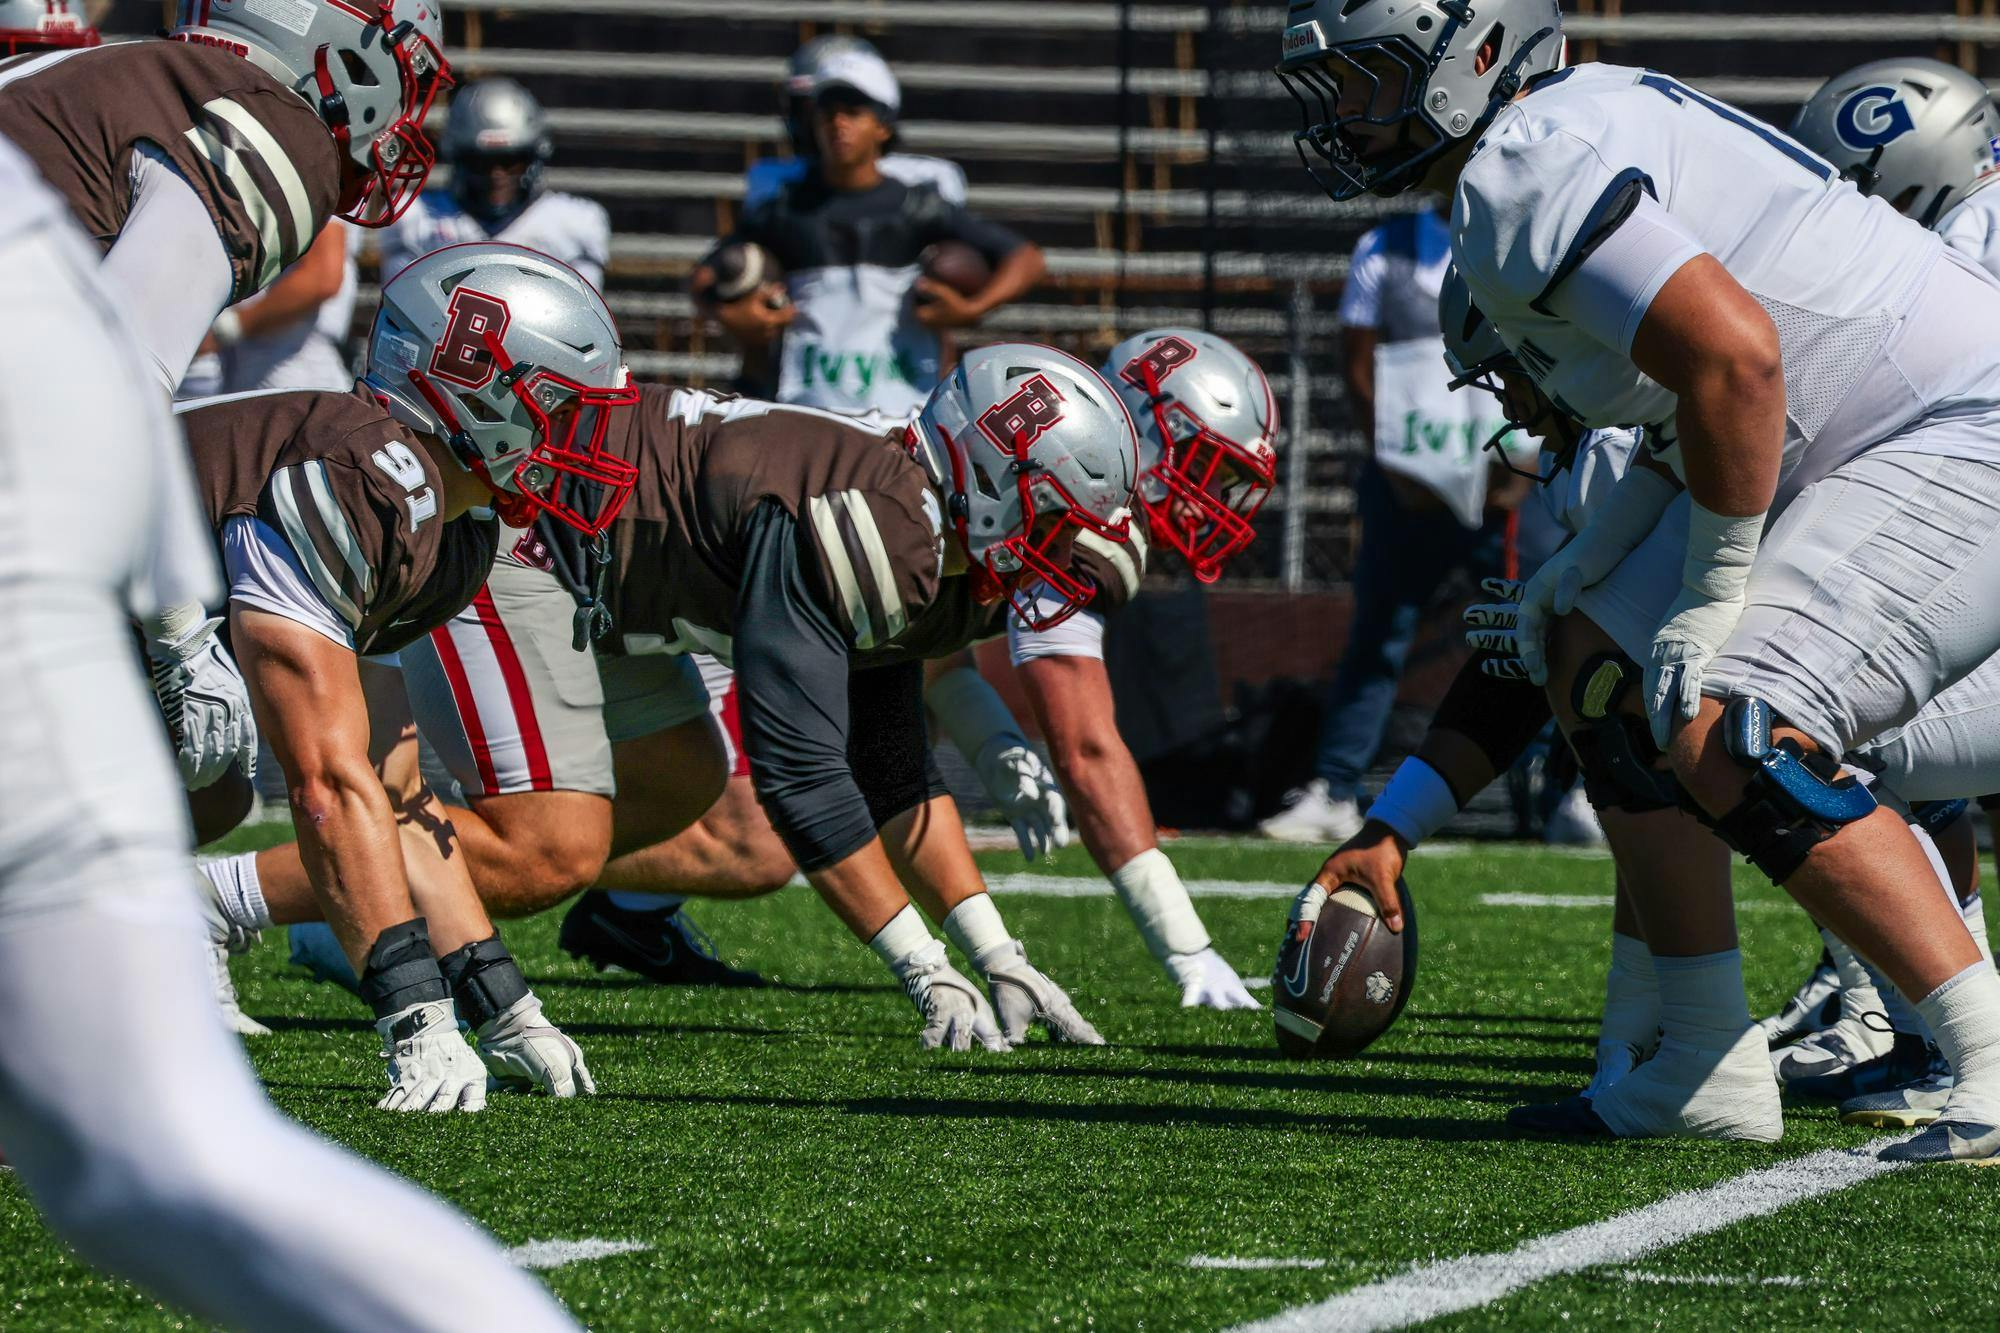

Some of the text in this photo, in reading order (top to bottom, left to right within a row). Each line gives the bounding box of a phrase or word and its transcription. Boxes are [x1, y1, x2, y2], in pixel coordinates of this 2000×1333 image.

[1833, 85, 1917, 151] G
[428, 286, 511, 391] B
[1117, 336, 1197, 394] B
[974, 373, 1069, 459] B
[1752, 703, 1761, 754] DONJOY
